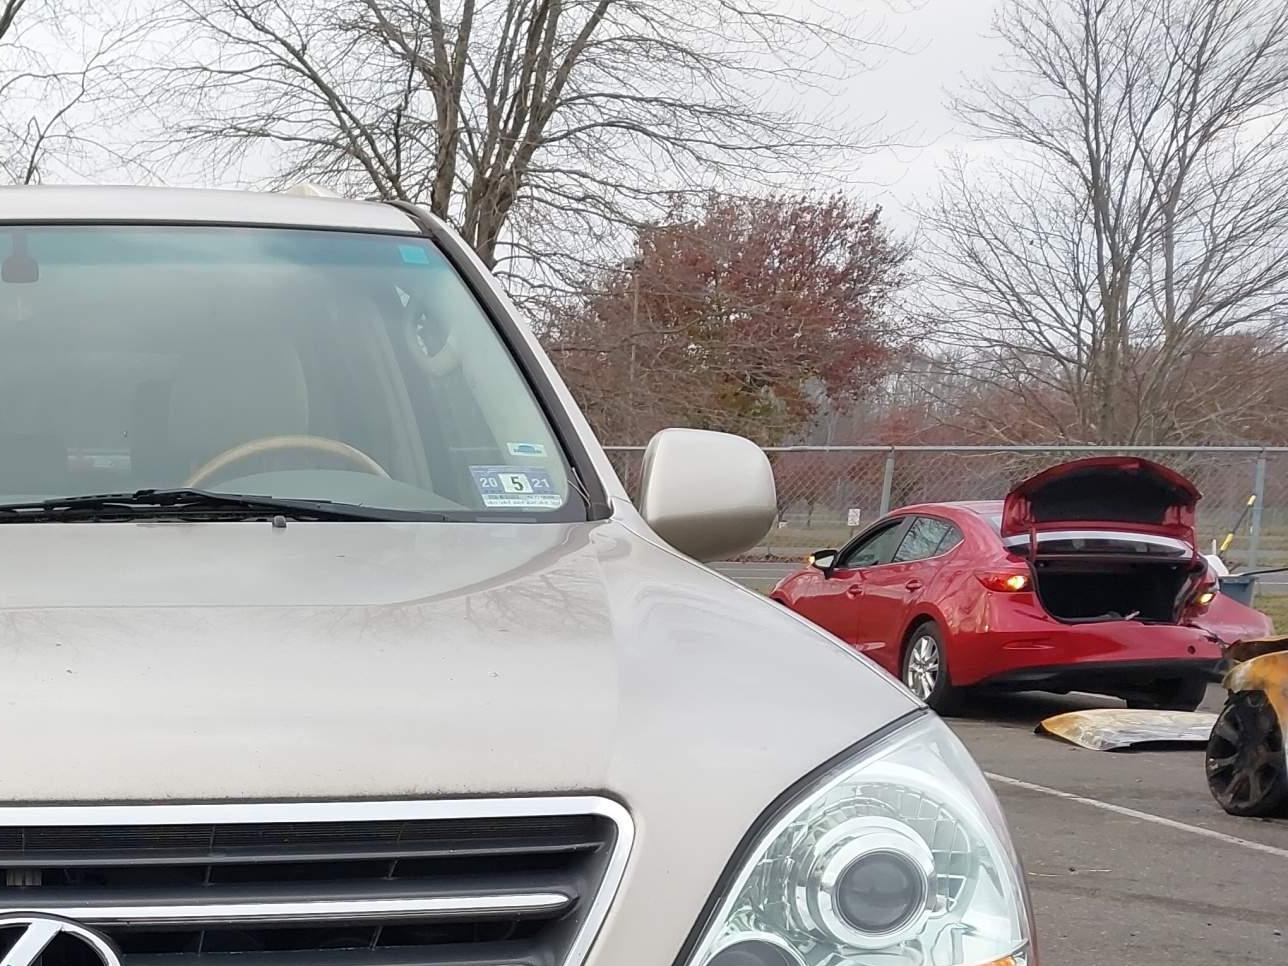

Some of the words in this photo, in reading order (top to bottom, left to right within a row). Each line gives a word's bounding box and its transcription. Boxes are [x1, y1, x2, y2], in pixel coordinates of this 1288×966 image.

[479, 477, 498, 488] 20
[510, 475, 524, 492] 5
[531, 478, 550, 488] 21
